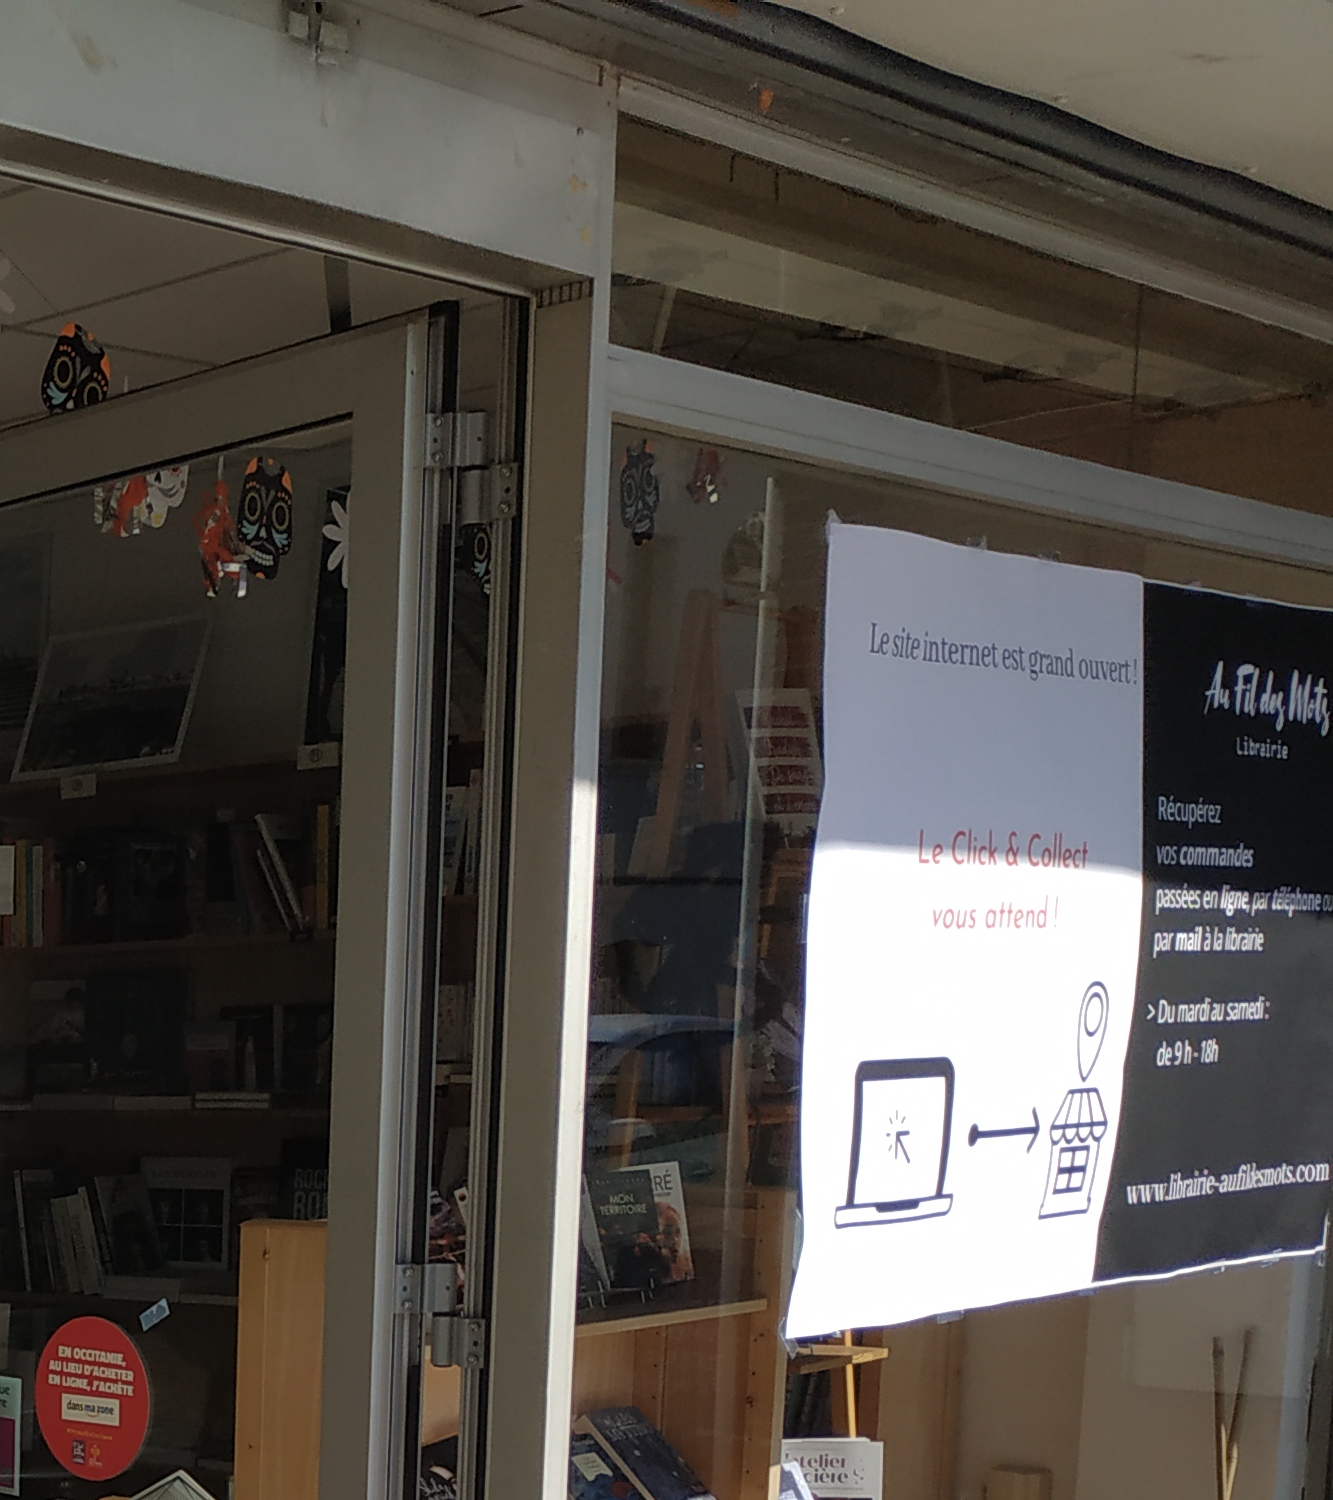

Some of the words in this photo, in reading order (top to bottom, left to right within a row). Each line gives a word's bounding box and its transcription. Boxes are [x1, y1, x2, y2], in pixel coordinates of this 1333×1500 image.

[870, 623, 891, 656] Le
[892, 627, 921, 661] site
[922, 631, 999, 669] internet
[1002, 647, 1026, 672] est
[1029, 648, 1076, 681] grand
[1236, 736, 1289, 759] Librairie
[1158, 795, 1222, 829] Récupérez
[918, 829, 944, 864] Le
[951, 828, 997, 866] Click
[1028, 832, 1089, 869] Collect
[1156, 845, 1178, 865] vos
[1180, 843, 1254, 868] commandes
[933, 908, 976, 929] vous
[985, 894, 1048, 929] attend
[1175, 926, 1202, 952] mail
[600, 1204, 647, 1216] TERRITOIRE
[609, 1193, 634, 1205] MON
[58, 1346, 71, 1358] EN
[73, 1348, 126, 1367] OCCITANIE,
[49, 1360, 61, 1372] AU
[63, 1361, 83, 1374] LIEU
[84, 1364, 134, 1382] D'ACHETER
[48, 1374, 60, 1385] EN
[62, 1376, 90, 1391] LIGNE,
[92, 1380, 134, 1397] J'ACHÈTE
[67, 1400, 83, 1412] dans
[84, 1404, 95, 1412] ma
[97, 1405, 114, 1415] zone
